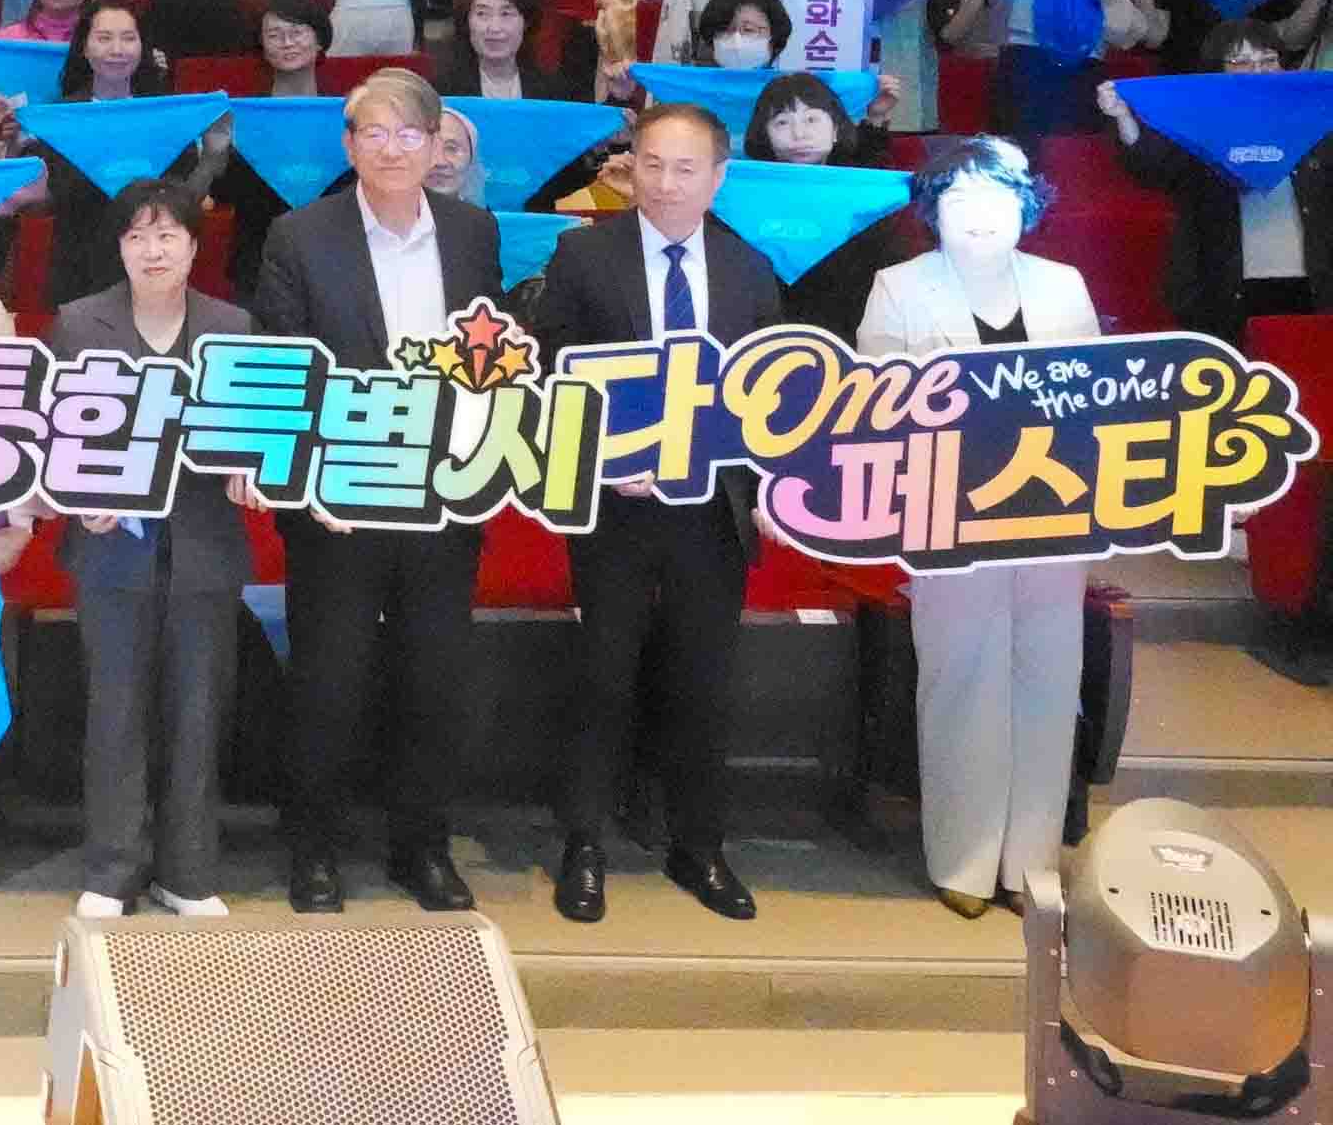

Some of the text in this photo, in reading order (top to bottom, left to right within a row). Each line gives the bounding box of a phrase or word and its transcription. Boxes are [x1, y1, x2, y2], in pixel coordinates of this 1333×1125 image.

[968, 354, 1093, 401] We are
[1031, 362, 1176, 420] the One!
[771, 356, 1291, 553] 페스타
